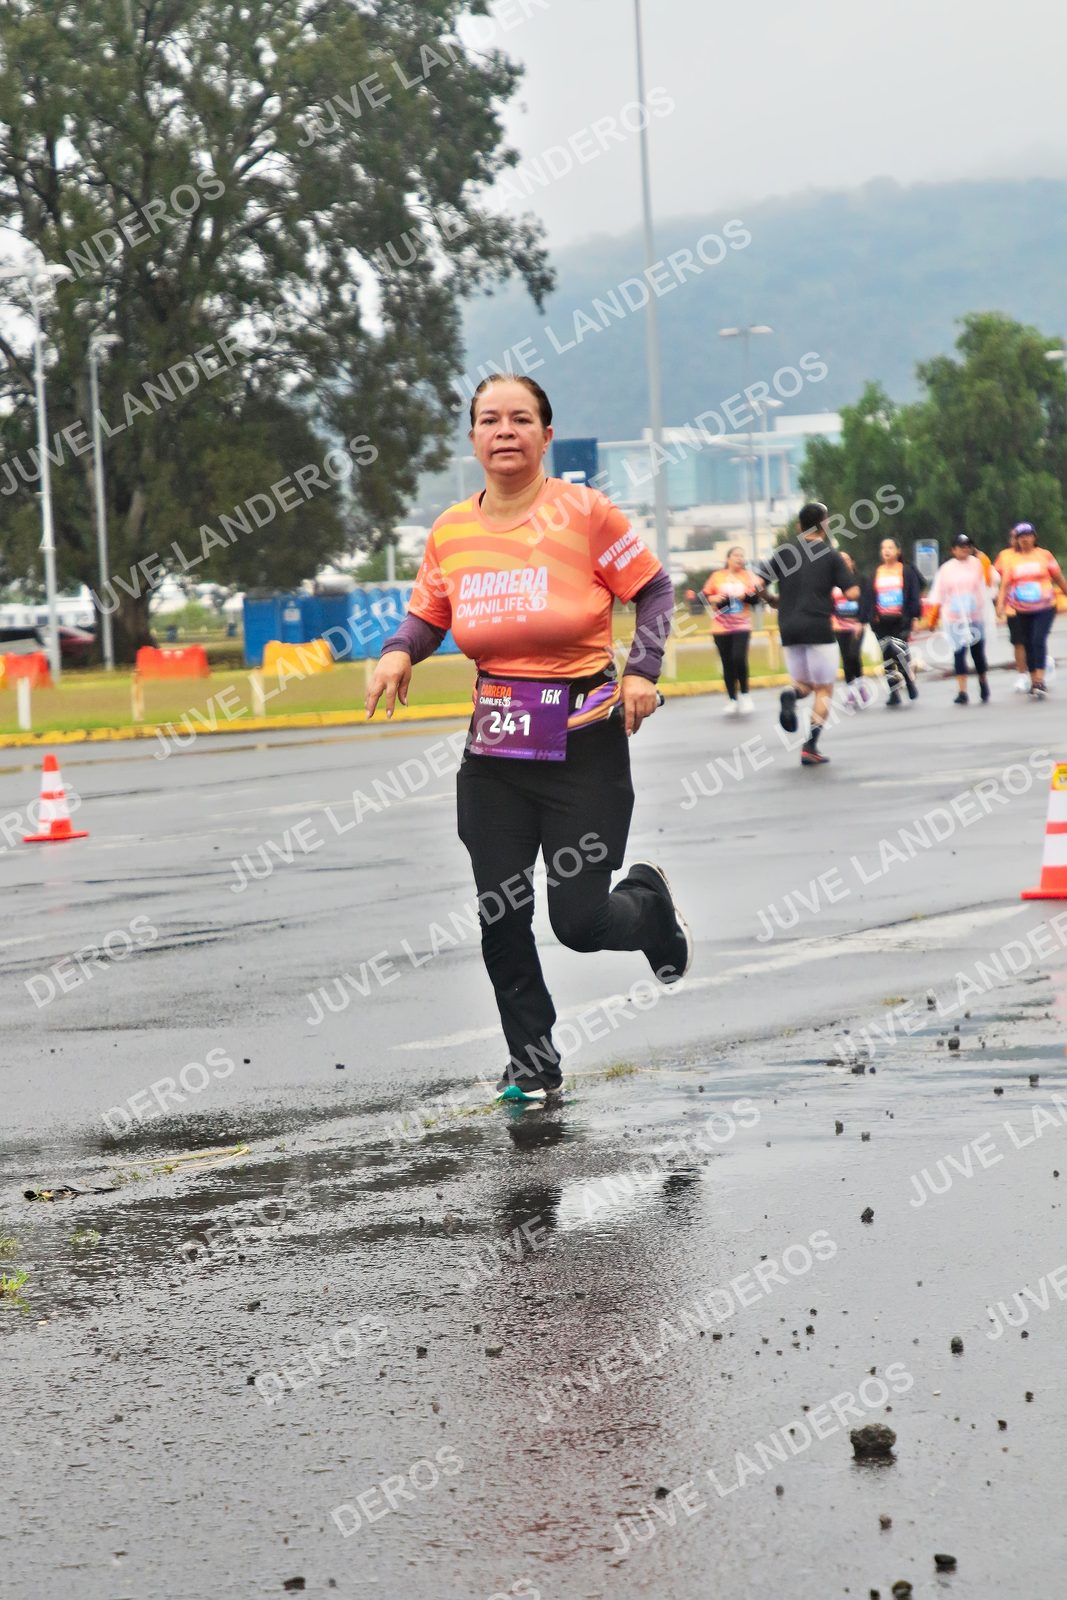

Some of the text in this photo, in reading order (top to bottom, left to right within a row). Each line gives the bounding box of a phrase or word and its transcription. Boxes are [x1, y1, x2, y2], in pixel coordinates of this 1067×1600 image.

[459, 566, 548, 600] CARRERA
[456, 597, 525, 618] OMNILIFE
[480, 683, 512, 698] CARRERA
[489, 711, 531, 736] 241
